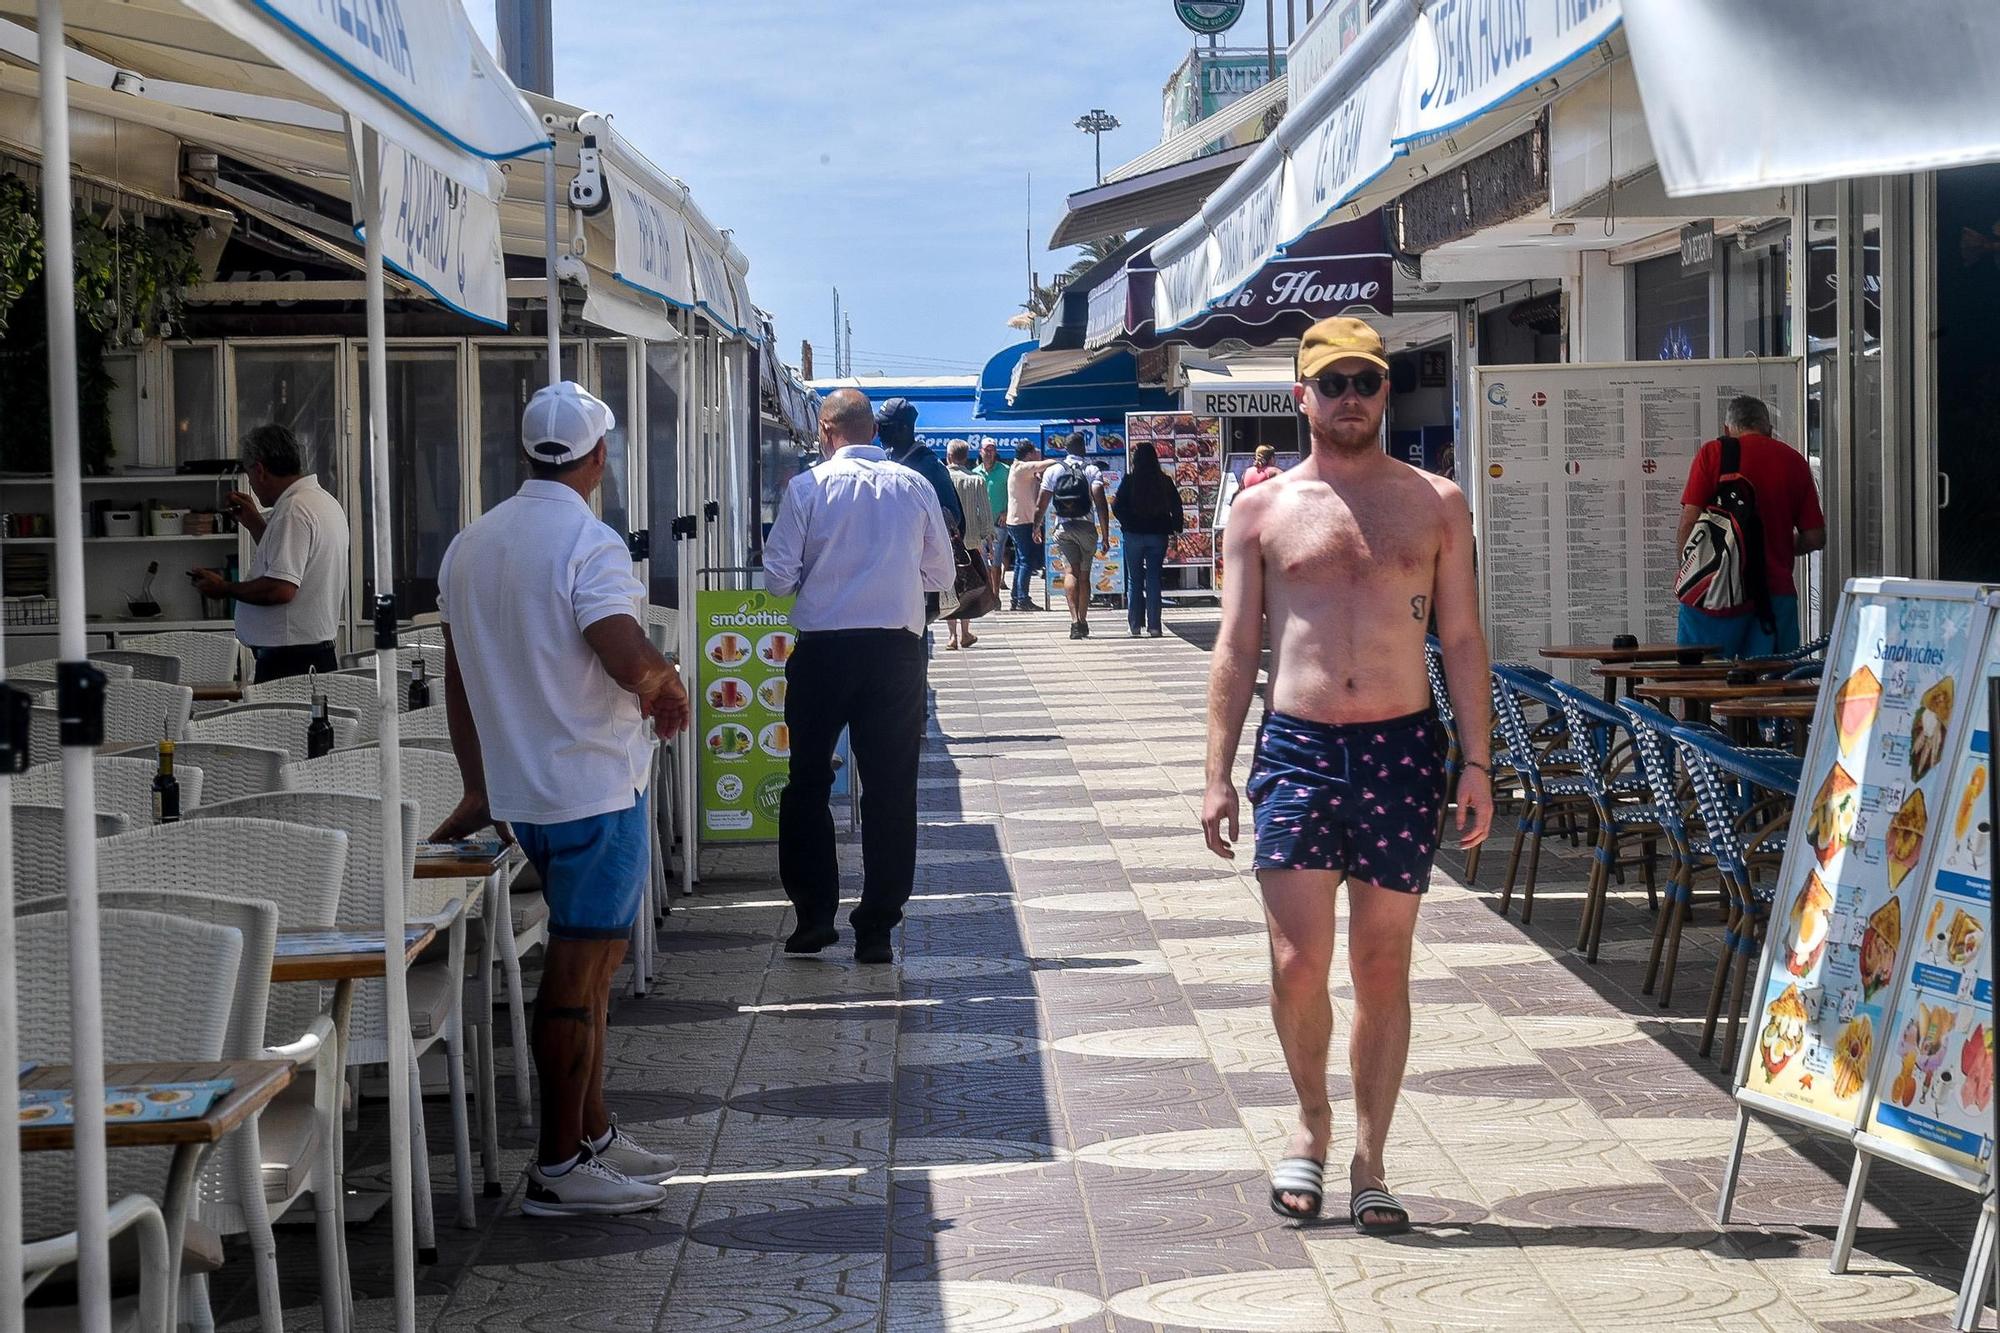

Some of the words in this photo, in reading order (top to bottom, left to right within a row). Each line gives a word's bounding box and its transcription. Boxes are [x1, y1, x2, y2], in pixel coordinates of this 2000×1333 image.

[1266, 269, 1380, 306] House
[1206, 394, 1299, 414] RESTAURA
[711, 610, 788, 626] smoothie
[1874, 638, 1945, 665] Sandwiches
